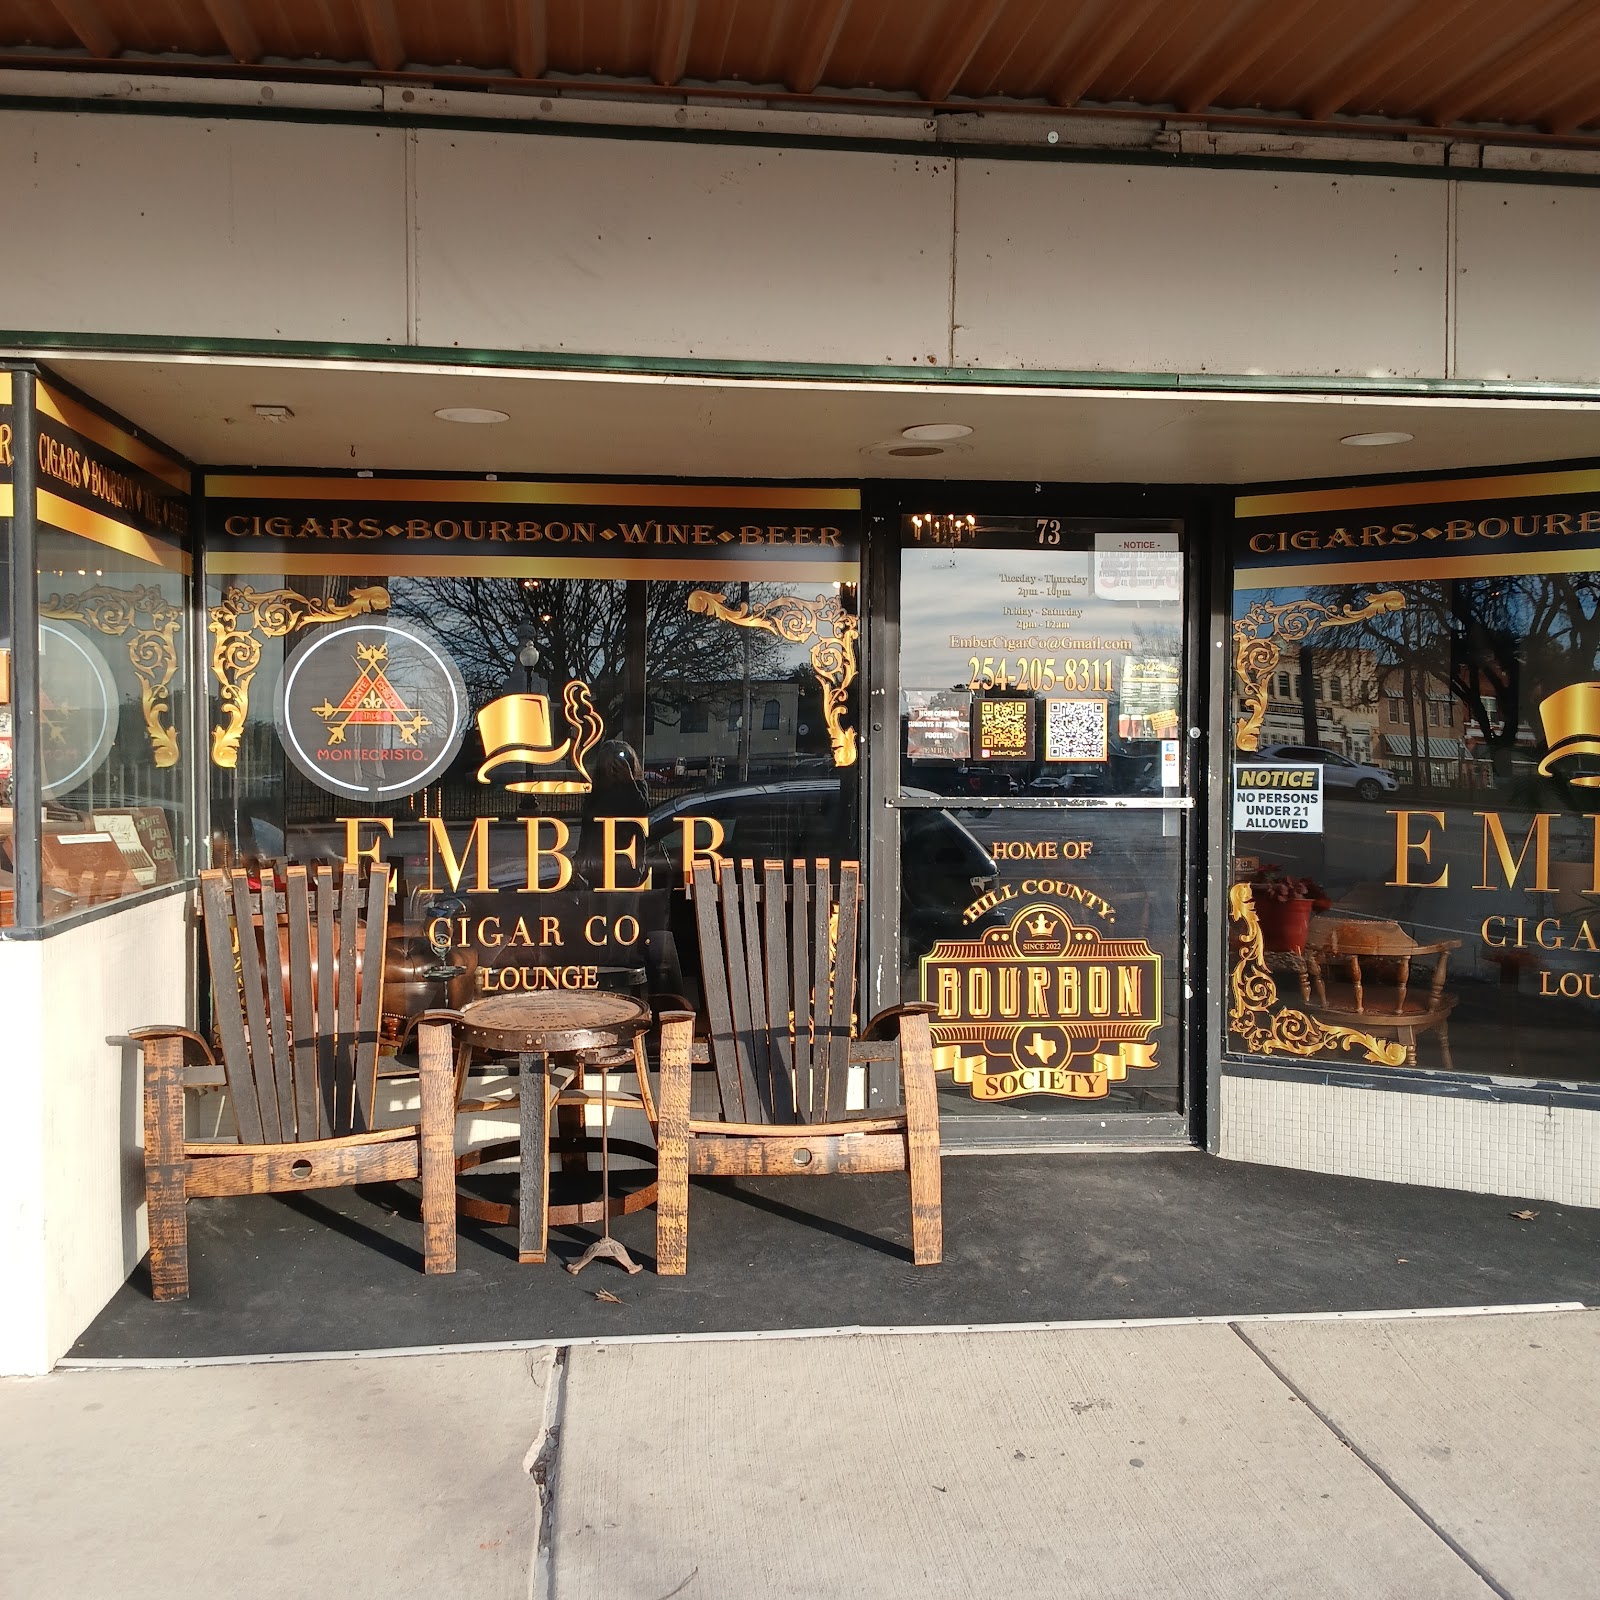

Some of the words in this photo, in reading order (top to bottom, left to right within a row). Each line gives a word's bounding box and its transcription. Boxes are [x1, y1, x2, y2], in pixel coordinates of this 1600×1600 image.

[38, 432, 81, 488] CIGARS
[224, 515, 384, 540] CIGARS
[405, 518, 597, 543] BOURBON
[617, 519, 719, 546] WINE
[738, 525, 845, 548] BEER
[1036, 518, 1061, 545] 73
[1249, 522, 1419, 553] CIGARS
[1123, 541, 1156, 549] NOTICE
[999, 573, 1036, 585] Tuesday
[1044, 574, 1088, 586] Thursday
[1017, 586, 1038, 598] 2pm
[1047, 587, 1071, 598] 10pm
[1041, 607, 1083, 618] Saturday
[1016, 620, 1037, 630] 2pm
[1045, 621, 1070, 629] 12am
[949, 634, 1133, 652] EmberCigarCo@Gmail.com
[968, 655, 1114, 692] 254-205-8311
[346, 680, 369, 707] MONTE
[376, 681, 398, 707] CRISTO
[925, 731, 953, 739] FOOTBALL
[316, 748, 424, 761] MONTECRISTO
[1240, 770, 1315, 788] NOTICE
[1237, 792, 1256, 803] NO
[1258, 793, 1319, 804] PERSONS
[1246, 805, 1291, 816] UNDER
[1293, 806, 1309, 816] 21
[1246, 818, 1309, 829] ALLOWED
[335, 816, 726, 893] EMBER
[991, 841, 1058, 860] HOME
[1063, 841, 1094, 860] OF
[964, 883, 1019, 923] HILL
[1021, 879, 1116, 920] COUNTY
[428, 914, 565, 948] CIGAR
[584, 914, 651, 947] CO.
[1481, 915, 1600, 952] CIGA
[1022, 942, 1045, 951] SINCE
[1046, 942, 1062, 950] 2022
[481, 965, 600, 991] LOUNGE
[936, 965, 1143, 1020] BOURBON
[984, 1069, 1101, 1096] SOCIETY
